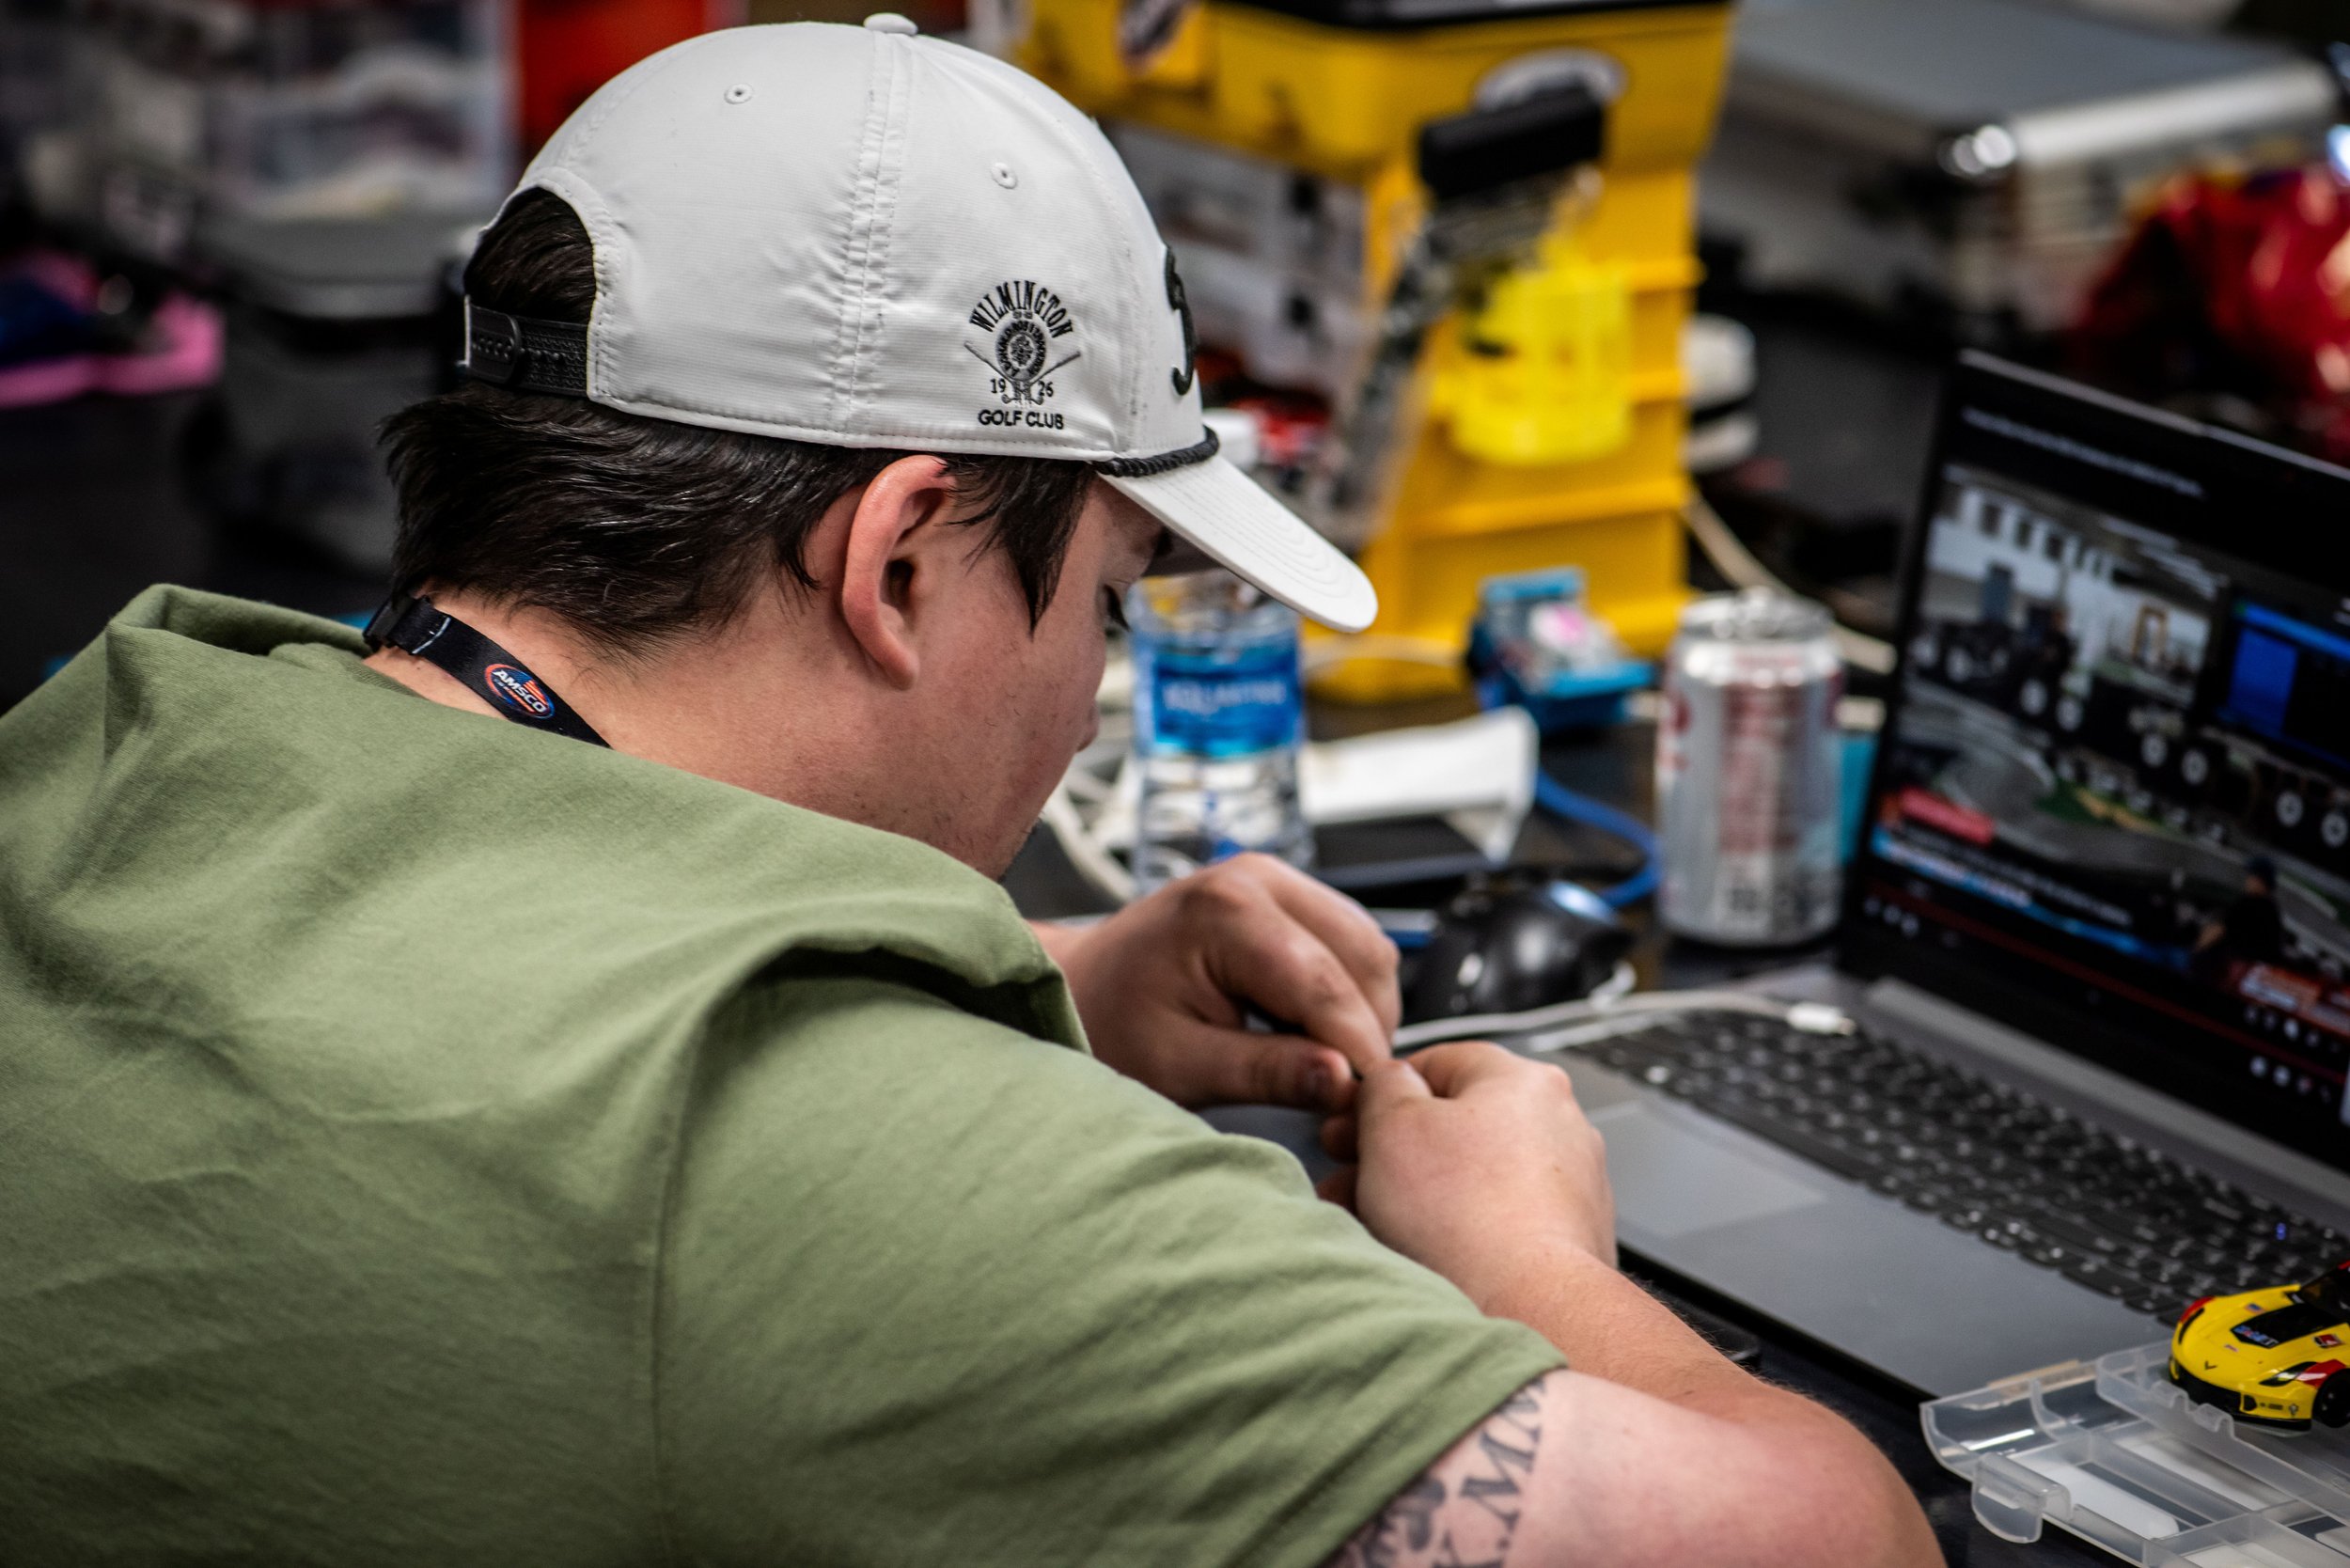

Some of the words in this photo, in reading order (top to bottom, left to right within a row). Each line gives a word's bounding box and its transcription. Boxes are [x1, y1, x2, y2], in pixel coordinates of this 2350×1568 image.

[970, 280, 1073, 338] WILMINGTON
[990, 378, 1006, 394] 19
[978, 409, 1023, 426] GOLF
[1026, 411, 1064, 430] CLUB
[494, 670, 546, 713] AMSCO
